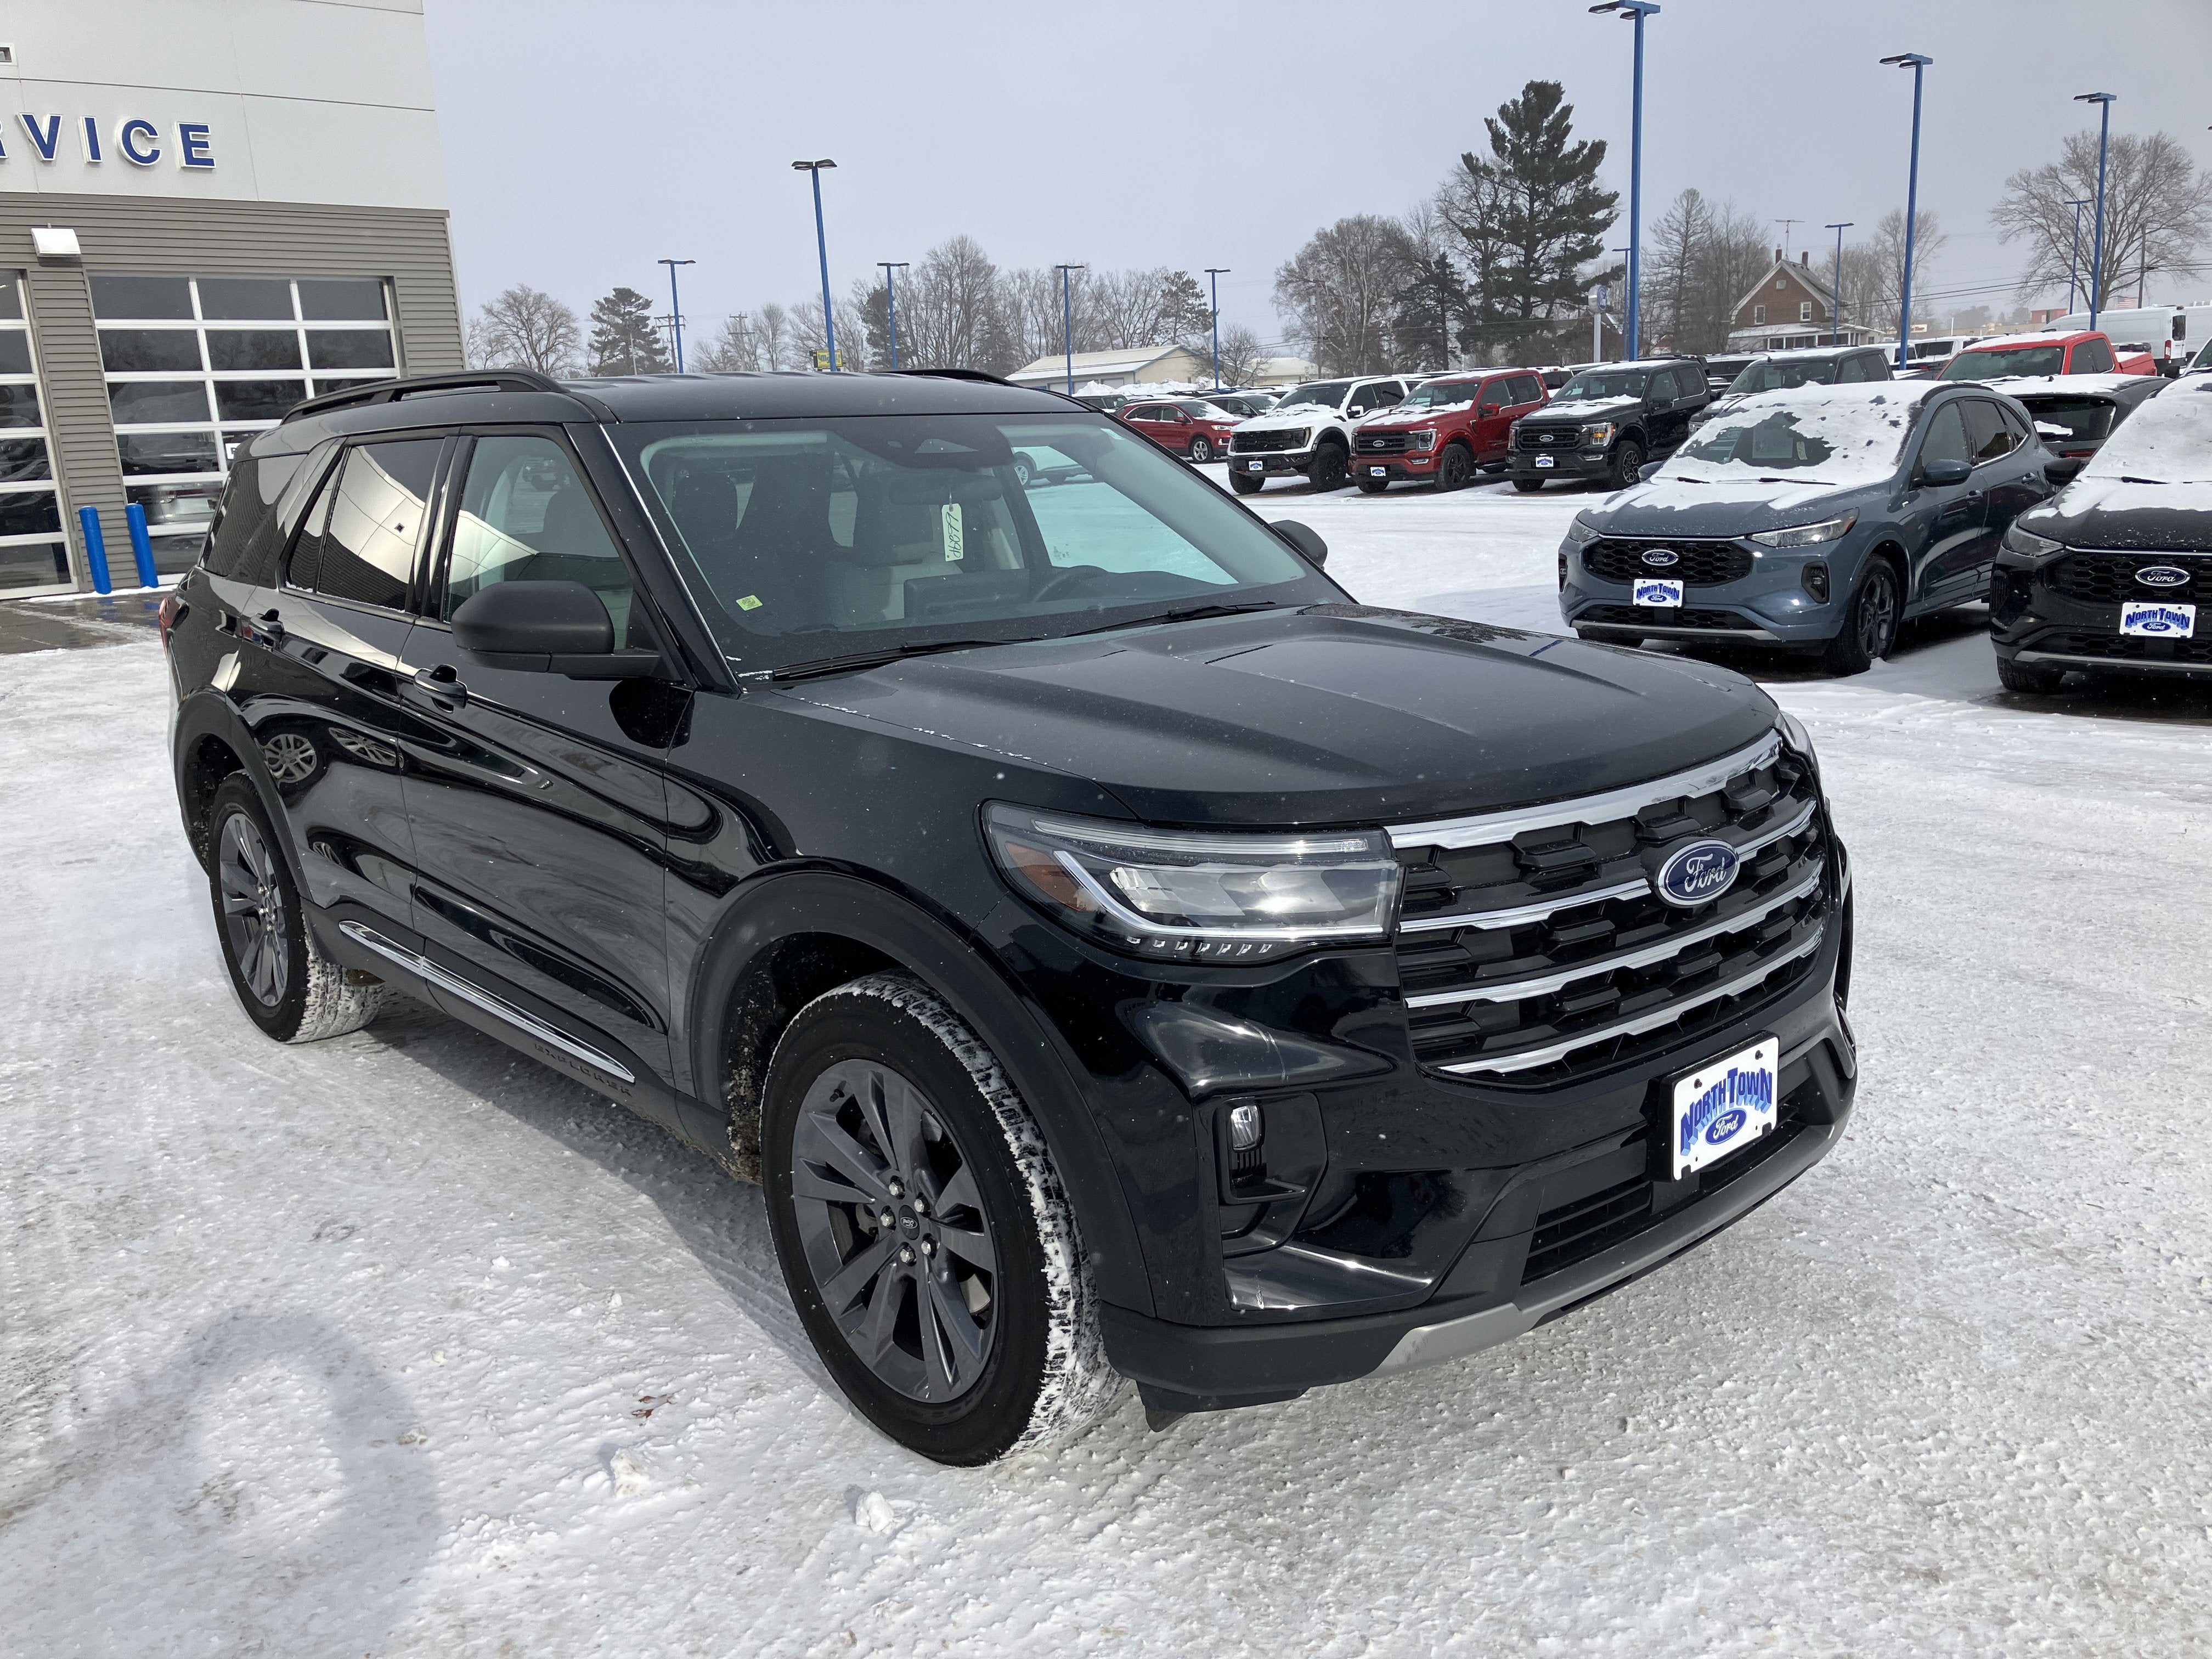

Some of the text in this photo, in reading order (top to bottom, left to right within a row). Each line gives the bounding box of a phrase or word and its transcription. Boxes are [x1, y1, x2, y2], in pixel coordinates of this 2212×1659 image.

[945, 511, 962, 558] 6629P
[1649, 552, 1669, 562] Ford
[2147, 570, 2177, 582] Ford
[1636, 583, 1680, 601] NORTH TOWN
[2125, 607, 2191, 630] NORTH TOWN
[1684, 853, 1727, 893] Ford
[534, 1043, 633, 1097] EXPLORER
[1680, 1067, 1773, 1156] NORTH TOWN
[1713, 1113, 1739, 1141] Ford
[902, 1218, 915, 1227] Ford
